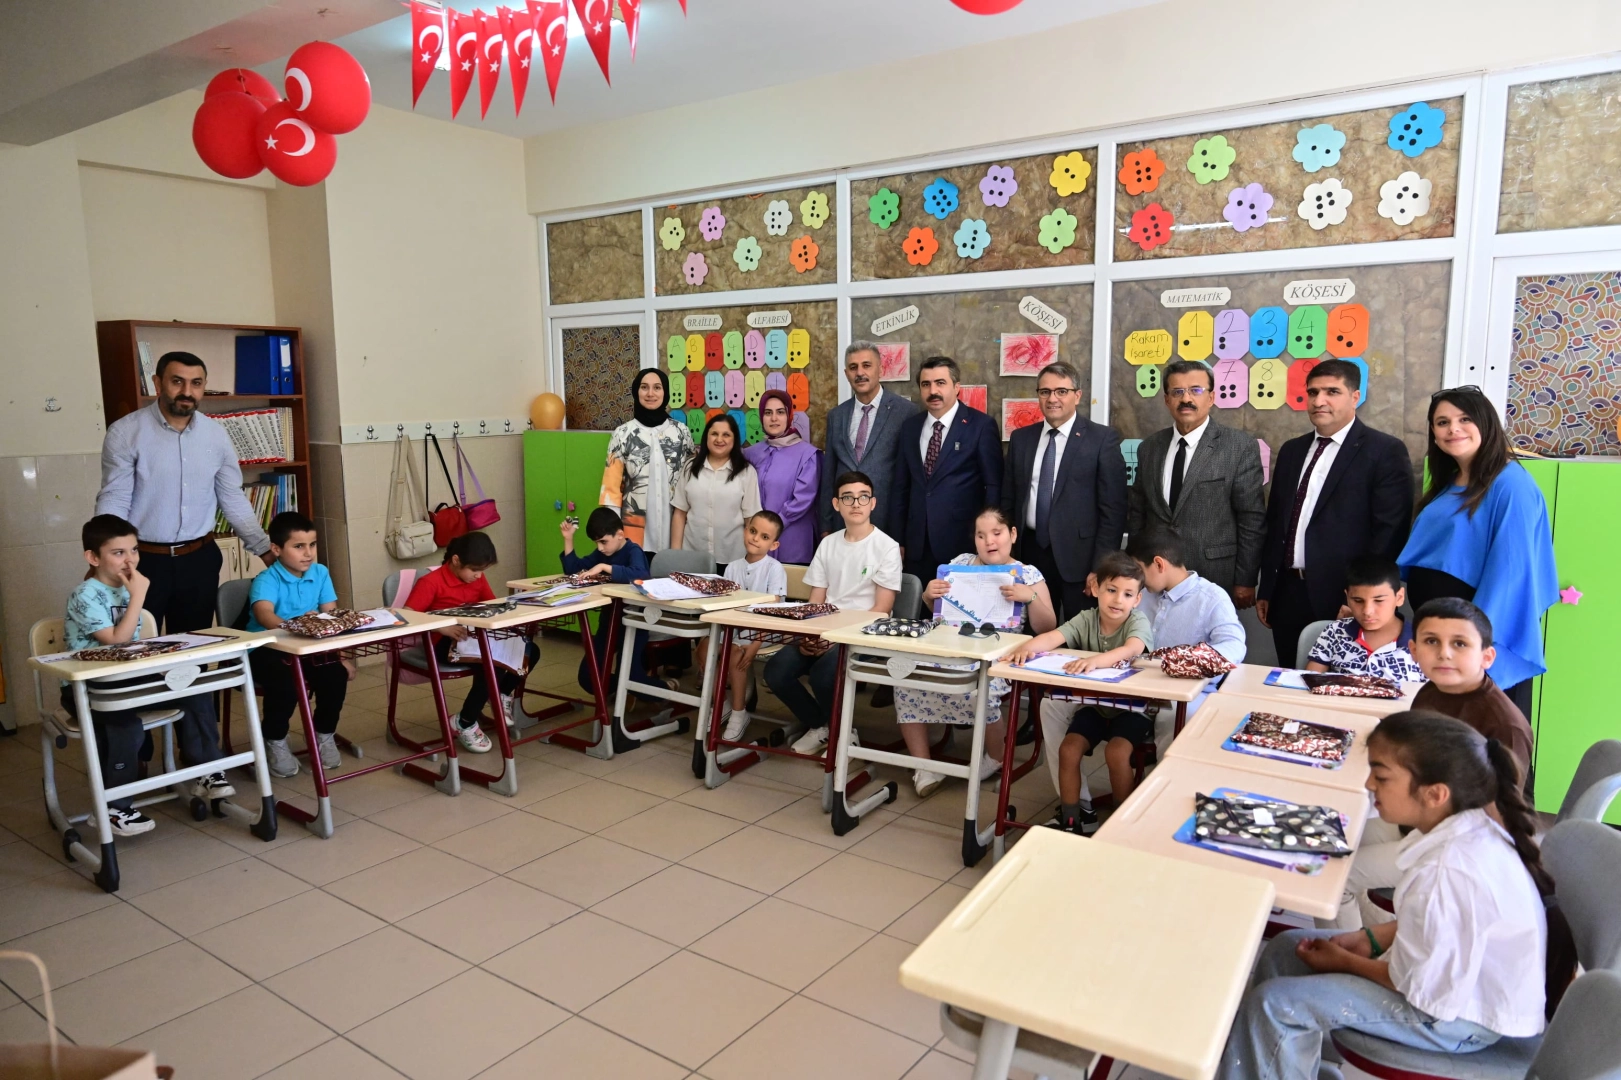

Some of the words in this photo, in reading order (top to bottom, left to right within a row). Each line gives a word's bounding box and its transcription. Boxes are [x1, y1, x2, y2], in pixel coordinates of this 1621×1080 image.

[1167, 291, 1223, 304] MATEMATİK
[1290, 282, 1347, 300] KÖŞESİ
[687, 316, 719, 327] BRAİLLE
[752, 313, 789, 325] ALFABESİ
[875, 309, 915, 332] ETKİNLİK
[1023, 301, 1064, 330] KÖŞESİ
[1189, 313, 1203, 337] 1
[1221, 311, 1244, 335] 2
[1260, 309, 1278, 338] 3
[1297, 309, 1315, 333] 4
[1339, 307, 1357, 333] 5
[671, 338, 681, 351] A
[689, 337, 698, 353] B
[709, 335, 719, 351] C
[749, 334, 759, 350] D
[770, 333, 779, 349] E
[792, 333, 801, 349] F
[1131, 332, 1169, 345] Rakam
[1220, 361, 1237, 382] 7
[1261, 361, 1274, 382] 8
[671, 375, 681, 391] G
[708, 374, 717, 389] H
[792, 375, 802, 390] K
[689, 414, 700, 428] M
